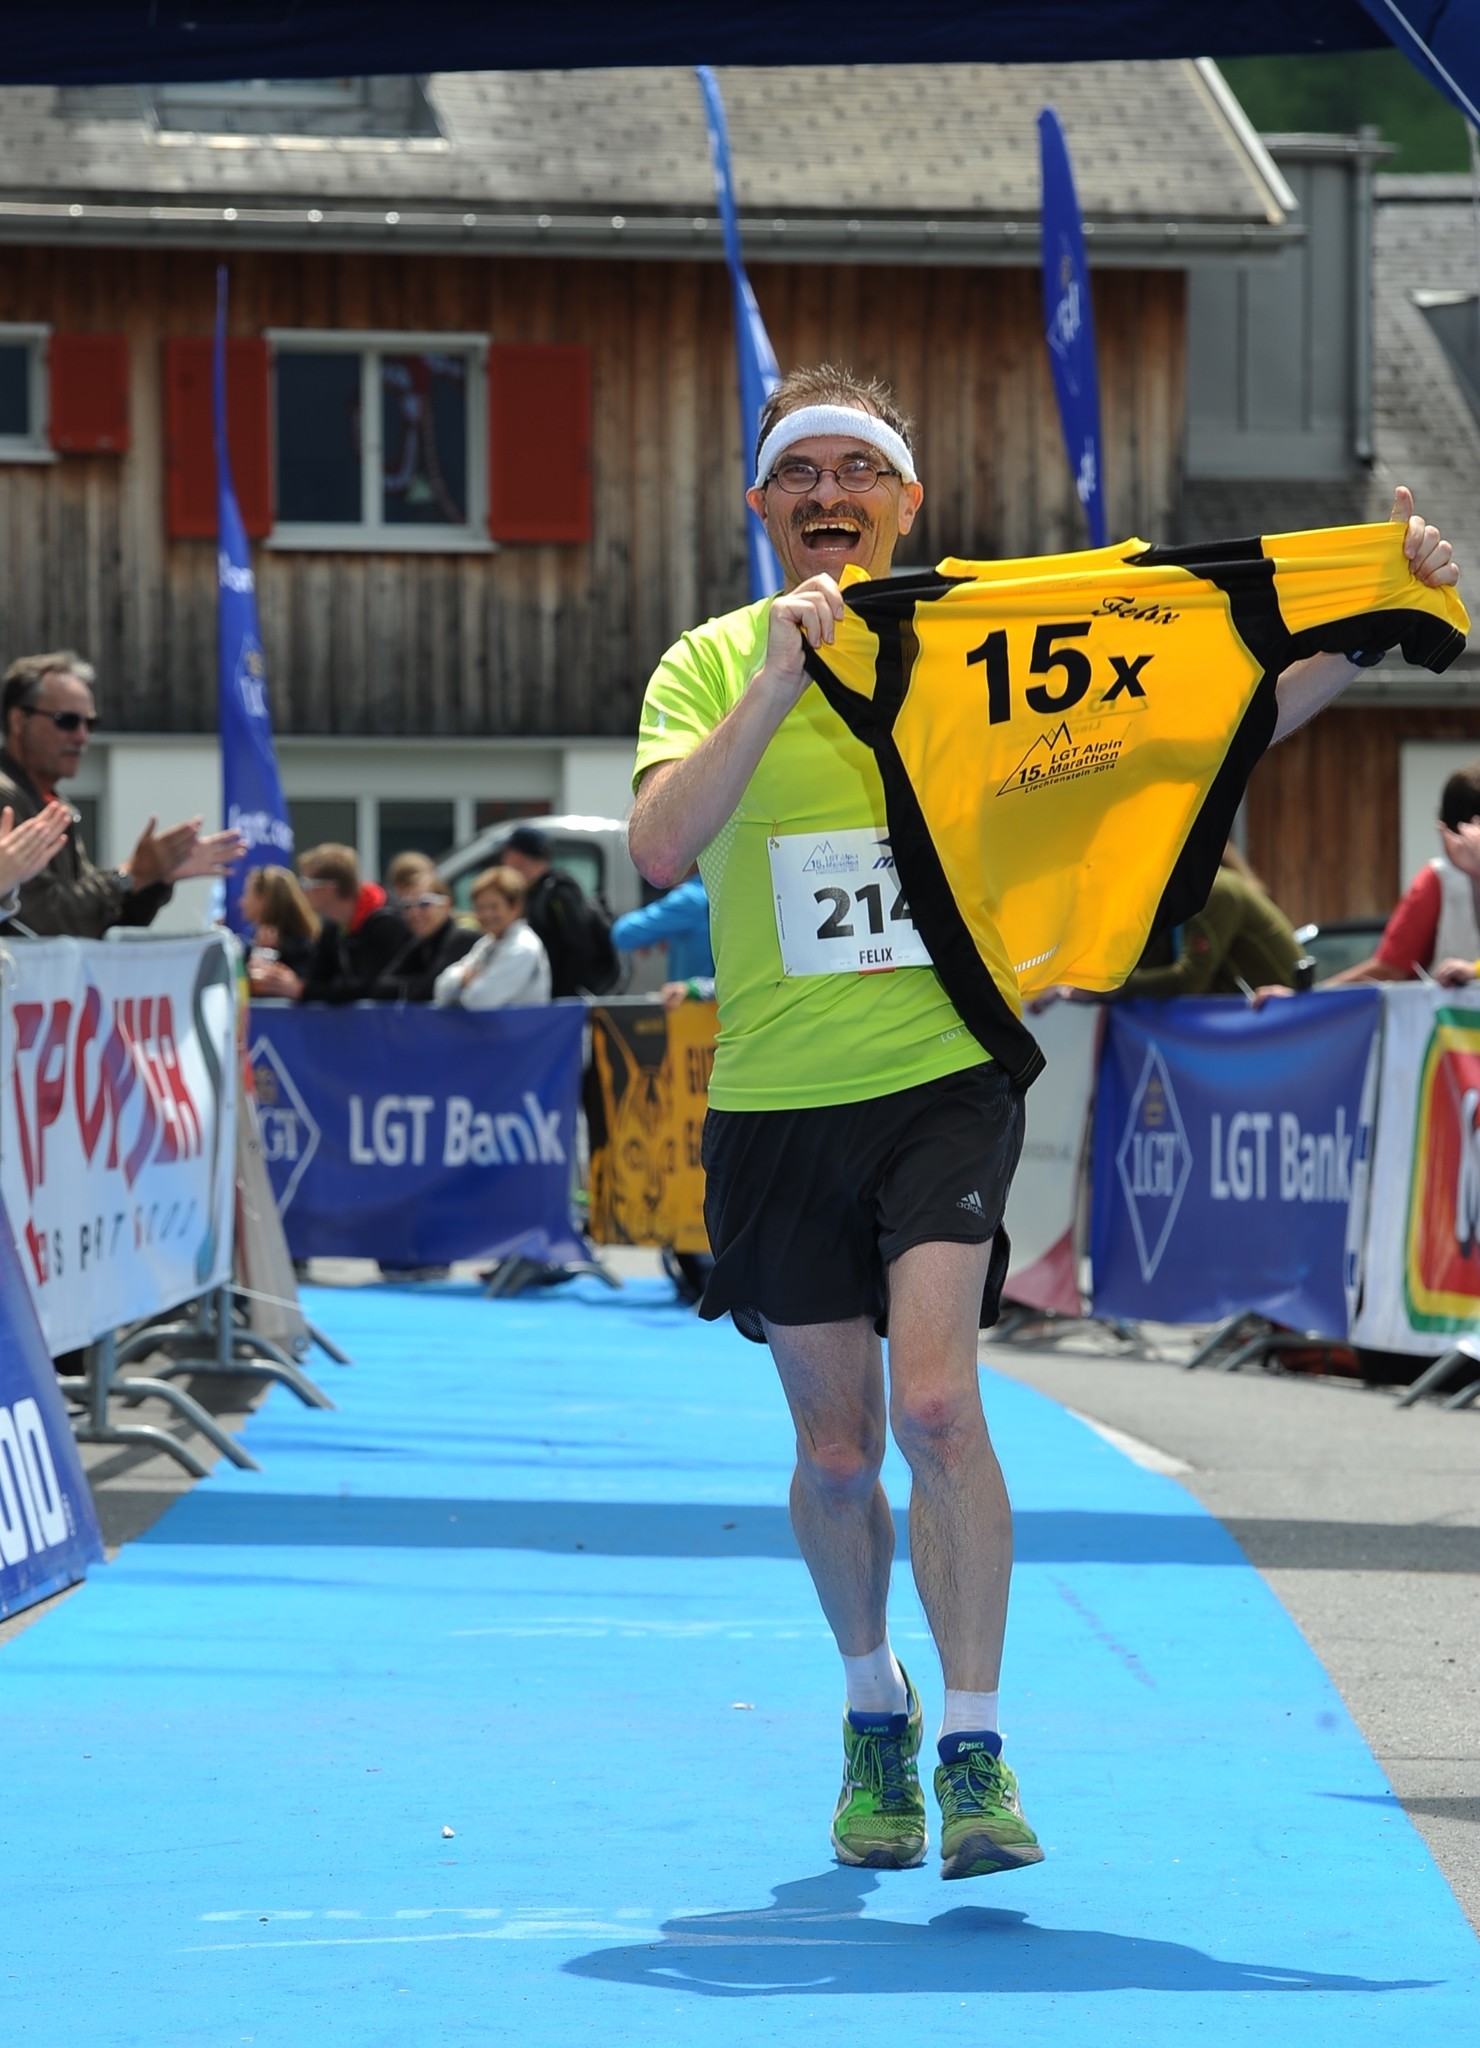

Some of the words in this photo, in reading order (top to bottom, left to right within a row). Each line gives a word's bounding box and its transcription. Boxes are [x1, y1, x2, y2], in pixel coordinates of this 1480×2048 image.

[1091, 596, 1180, 625] Felix
[1047, 751, 1120, 776] Marathon
[1050, 746, 1081, 765] LGT
[1083, 739, 1123, 756] Alpin
[1024, 769, 1091, 794] Liechtenstein
[1093, 762, 1116, 774] 2014
[859, 947, 893, 965] FELIX
[259, 1106, 299, 1163] GT
[349, 1094, 436, 1168] LGT
[442, 1090, 567, 1168] Bank
[1131, 1130, 1180, 1198] LGT
[1210, 1110, 1273, 1200] LGT
[1278, 1105, 1353, 1204] Bank
